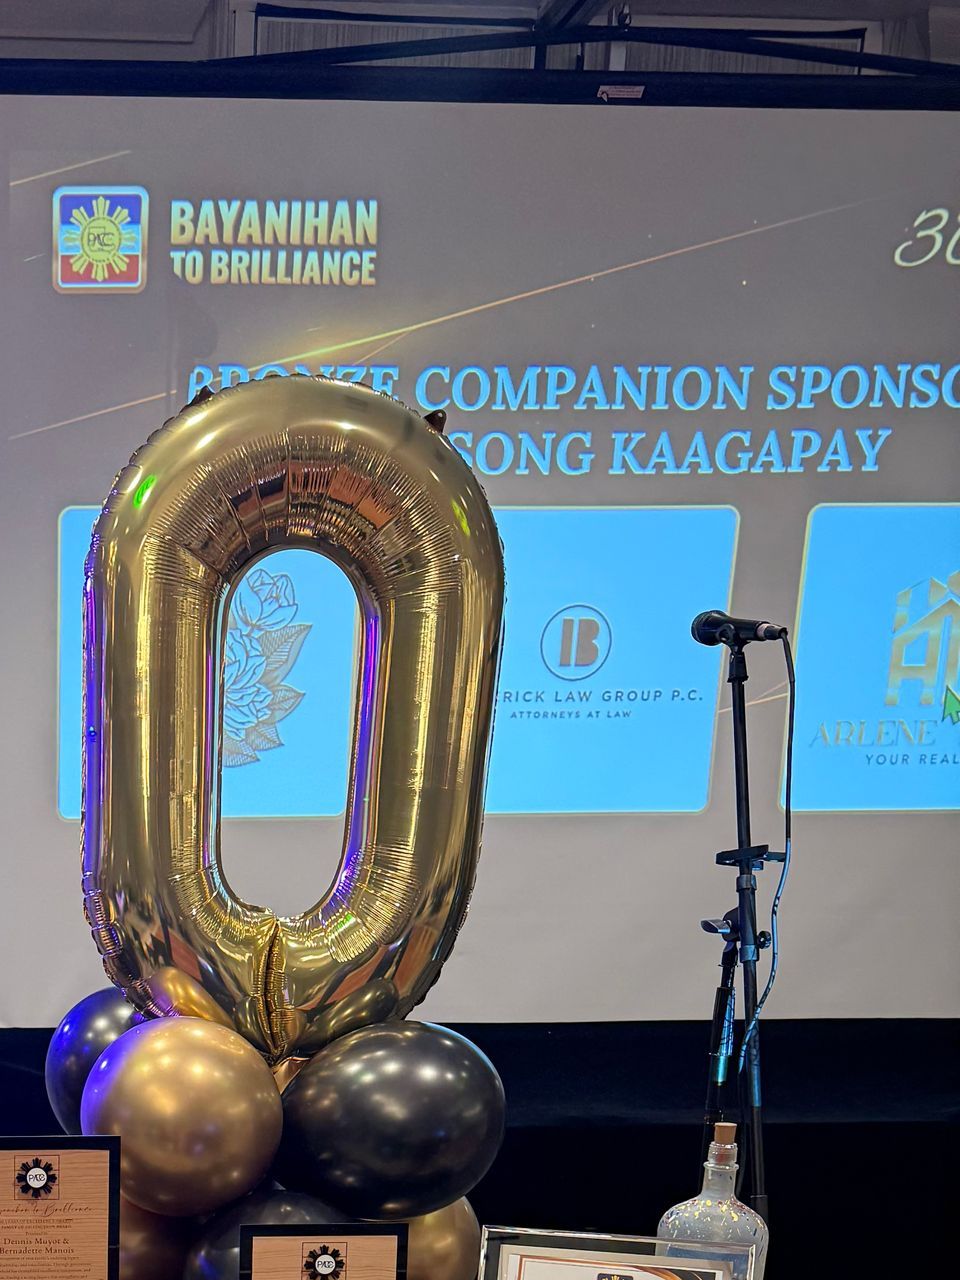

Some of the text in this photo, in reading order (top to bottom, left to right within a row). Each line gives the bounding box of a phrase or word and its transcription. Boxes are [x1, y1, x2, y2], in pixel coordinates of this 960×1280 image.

[170, 199, 377, 245] BAYANIHAN
[170, 249, 377, 286] TO BRILLIANCE
[415, 364, 755, 411] COMPANION
[608, 428, 892, 475] KAAGAPAY
[500, 689, 704, 703] RICK LAW GROUP P.C.
[510, 710, 632, 720] ATTORNEYS AT LAW
[809, 720, 938, 748] ARLENE
[865, 753, 910, 766] YOUR
